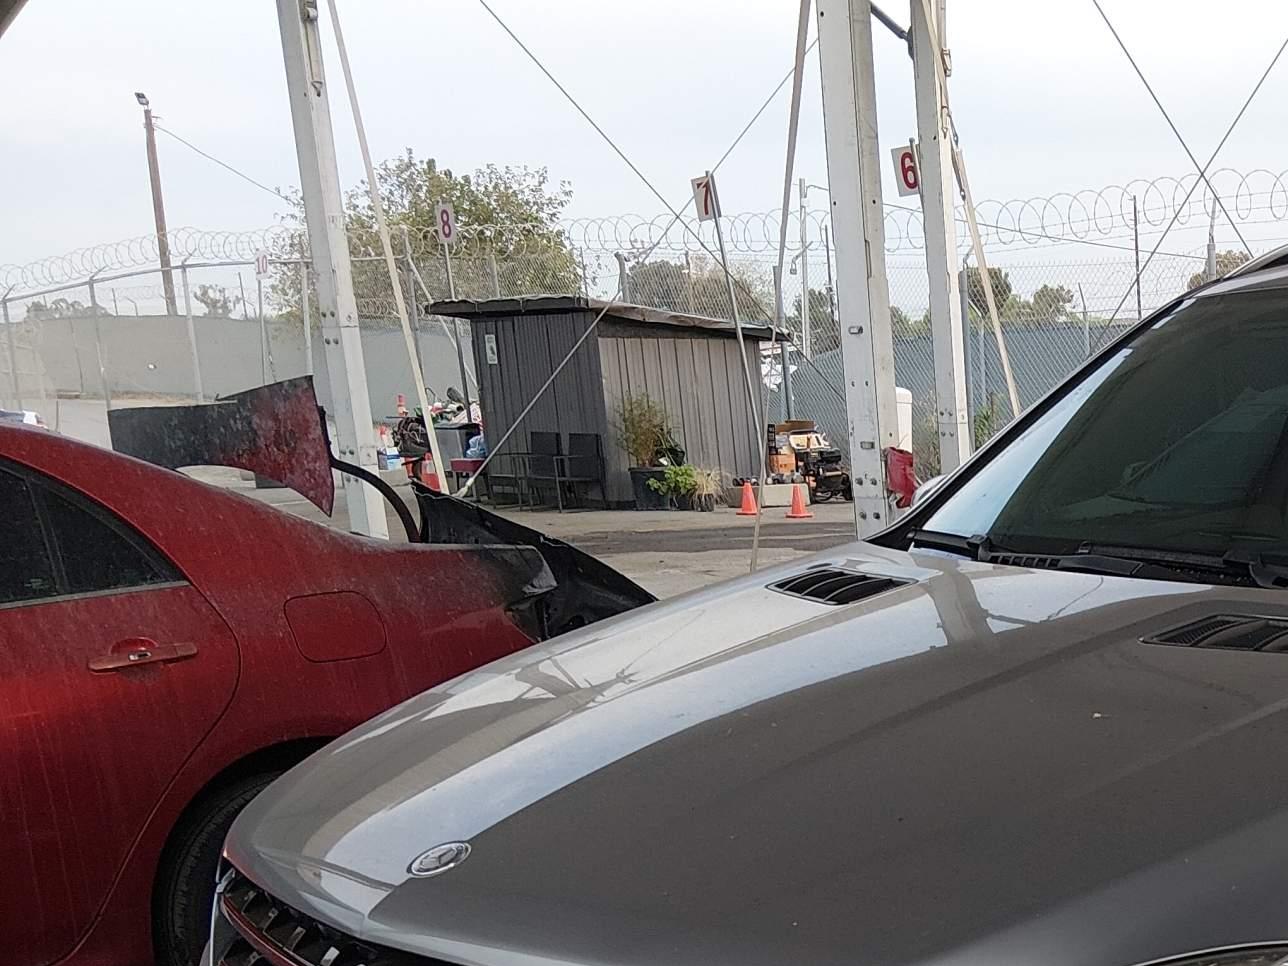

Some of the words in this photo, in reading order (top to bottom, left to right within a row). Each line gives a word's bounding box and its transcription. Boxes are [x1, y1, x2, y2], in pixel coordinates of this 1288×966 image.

[900, 151, 918, 190] 6
[695, 181, 710, 216] 7
[440, 208, 452, 239] 8
[255, 254, 268, 275] 10
